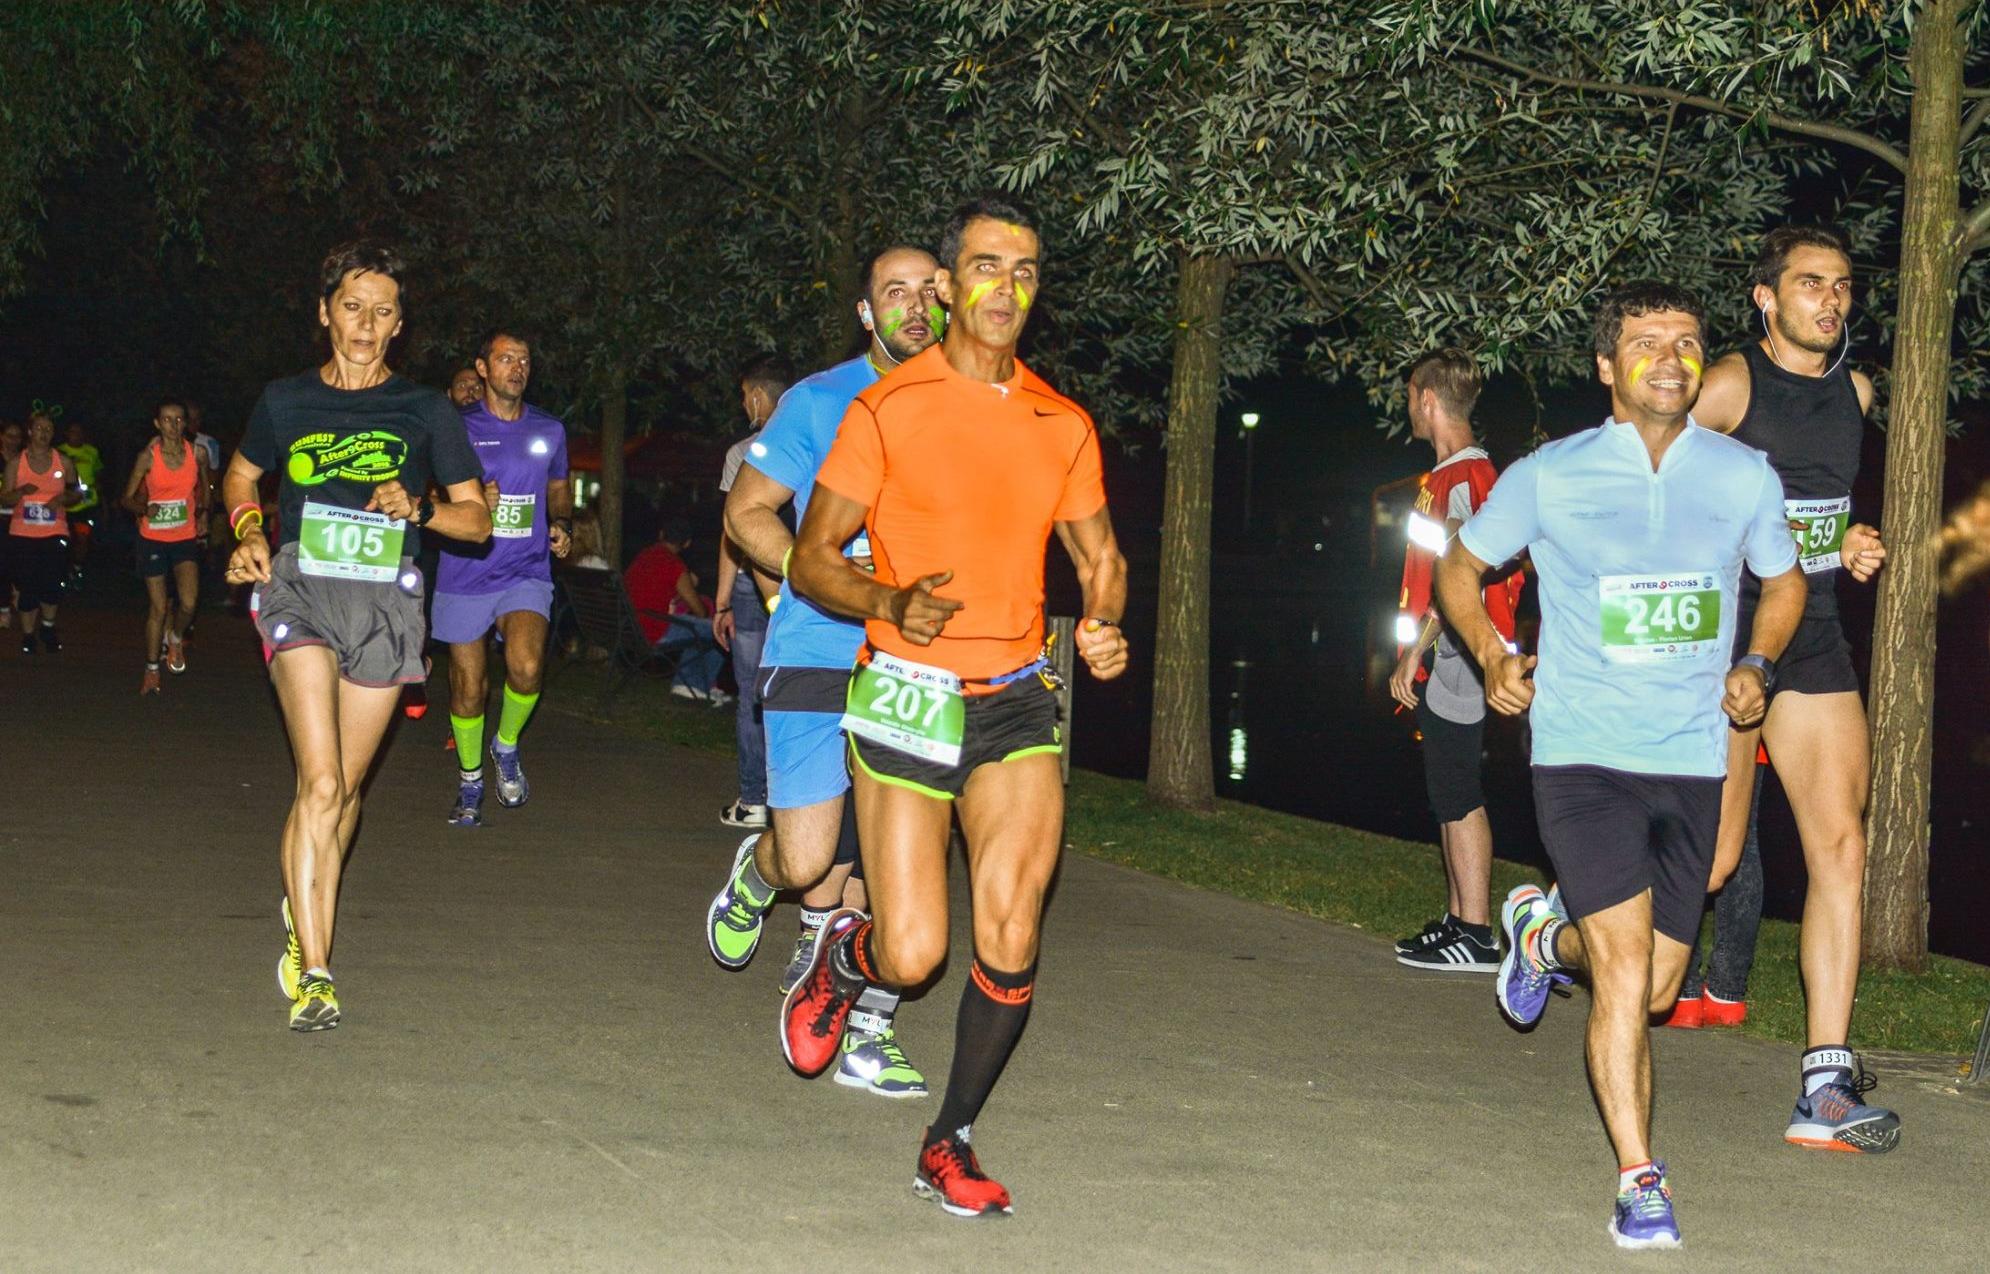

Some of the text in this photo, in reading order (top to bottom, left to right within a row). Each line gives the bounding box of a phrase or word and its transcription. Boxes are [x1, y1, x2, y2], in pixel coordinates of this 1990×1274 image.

[327, 510, 352, 519] AFTER
[360, 515, 385, 523] CROSS
[321, 523, 385, 557] 105
[1630, 581, 1658, 590] AFTER
[1668, 579, 1698, 588] CROSS
[1624, 594, 1701, 634] 246
[869, 676, 950, 727] 207
[1819, 1052, 1847, 1064] 1331
